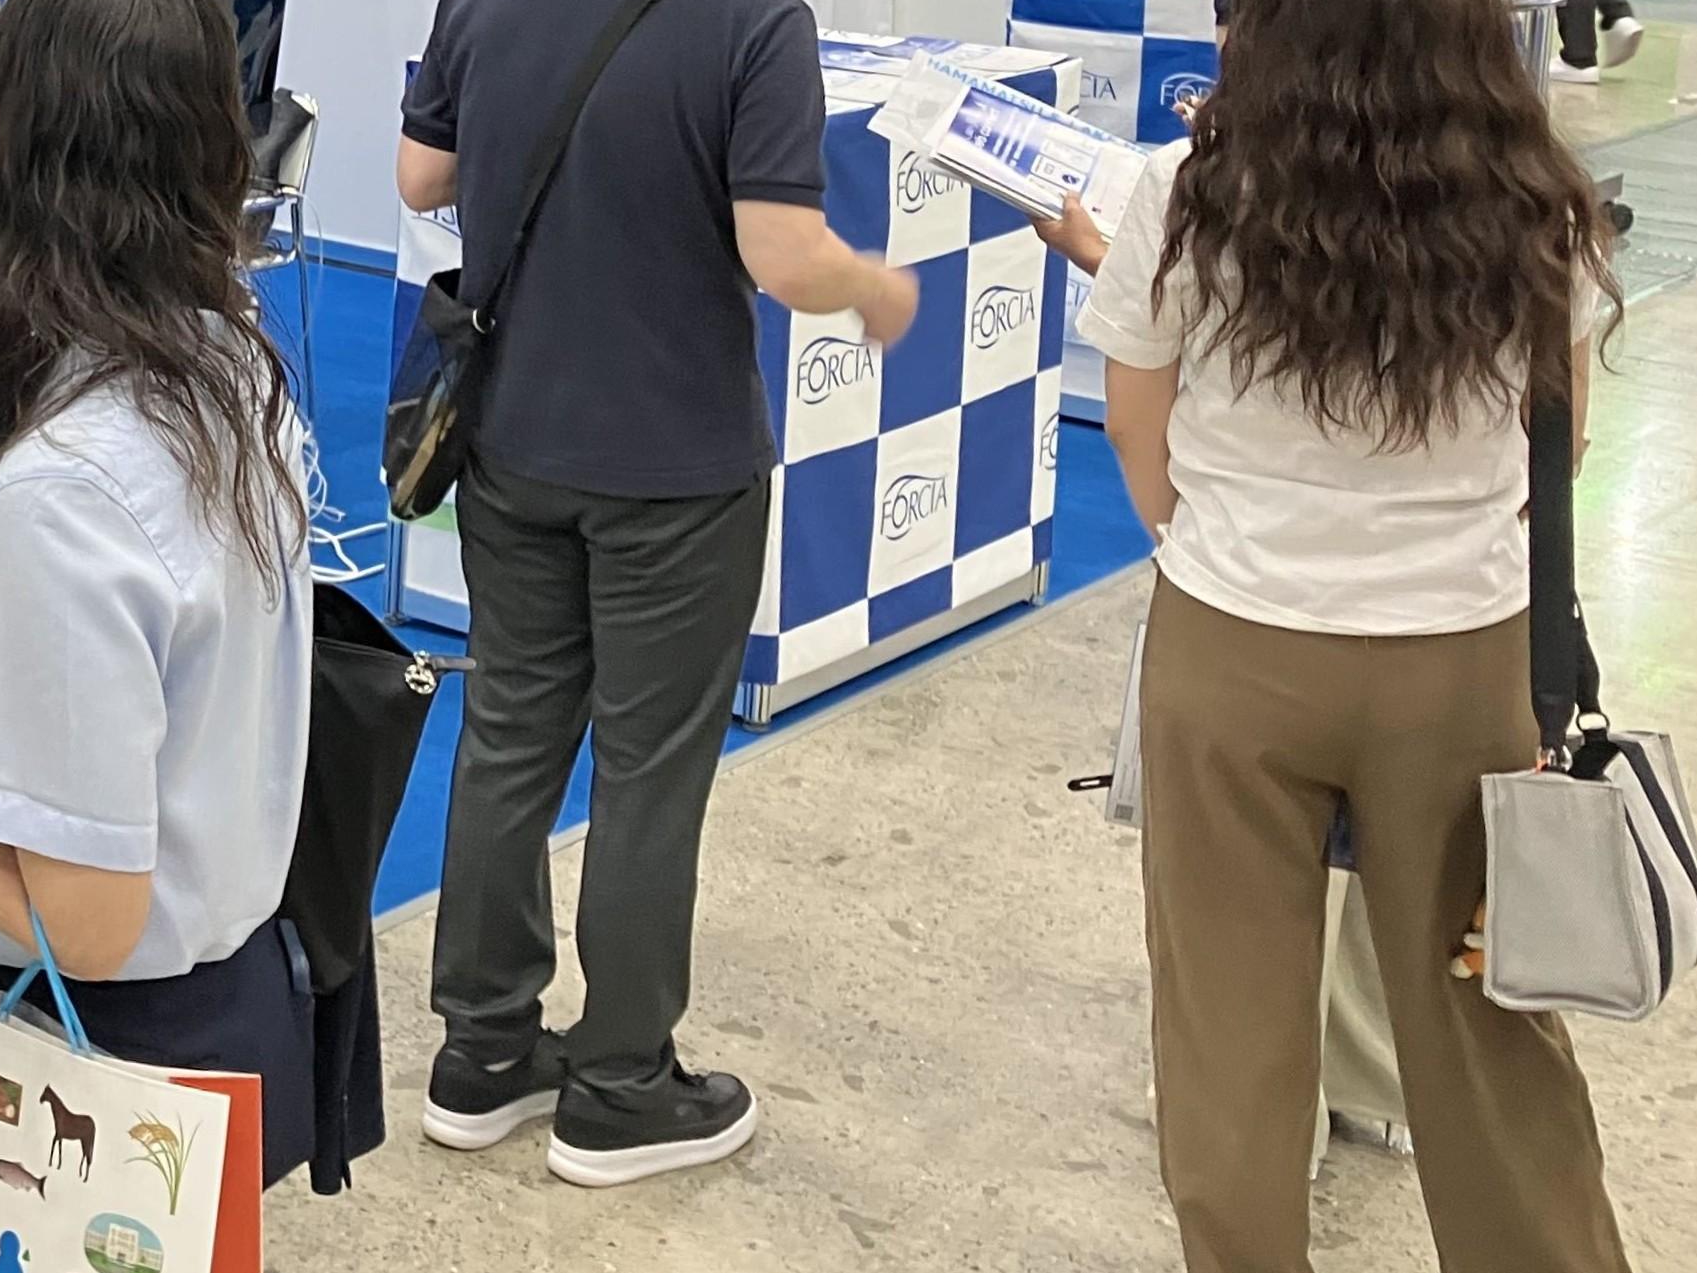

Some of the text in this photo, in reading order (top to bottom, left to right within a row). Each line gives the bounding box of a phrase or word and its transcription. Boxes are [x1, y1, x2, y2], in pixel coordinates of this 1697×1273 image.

[971, 288, 1035, 345] FORCIA
[796, 344, 875, 399] FORCIA
[880, 477, 947, 537] FORCIA
